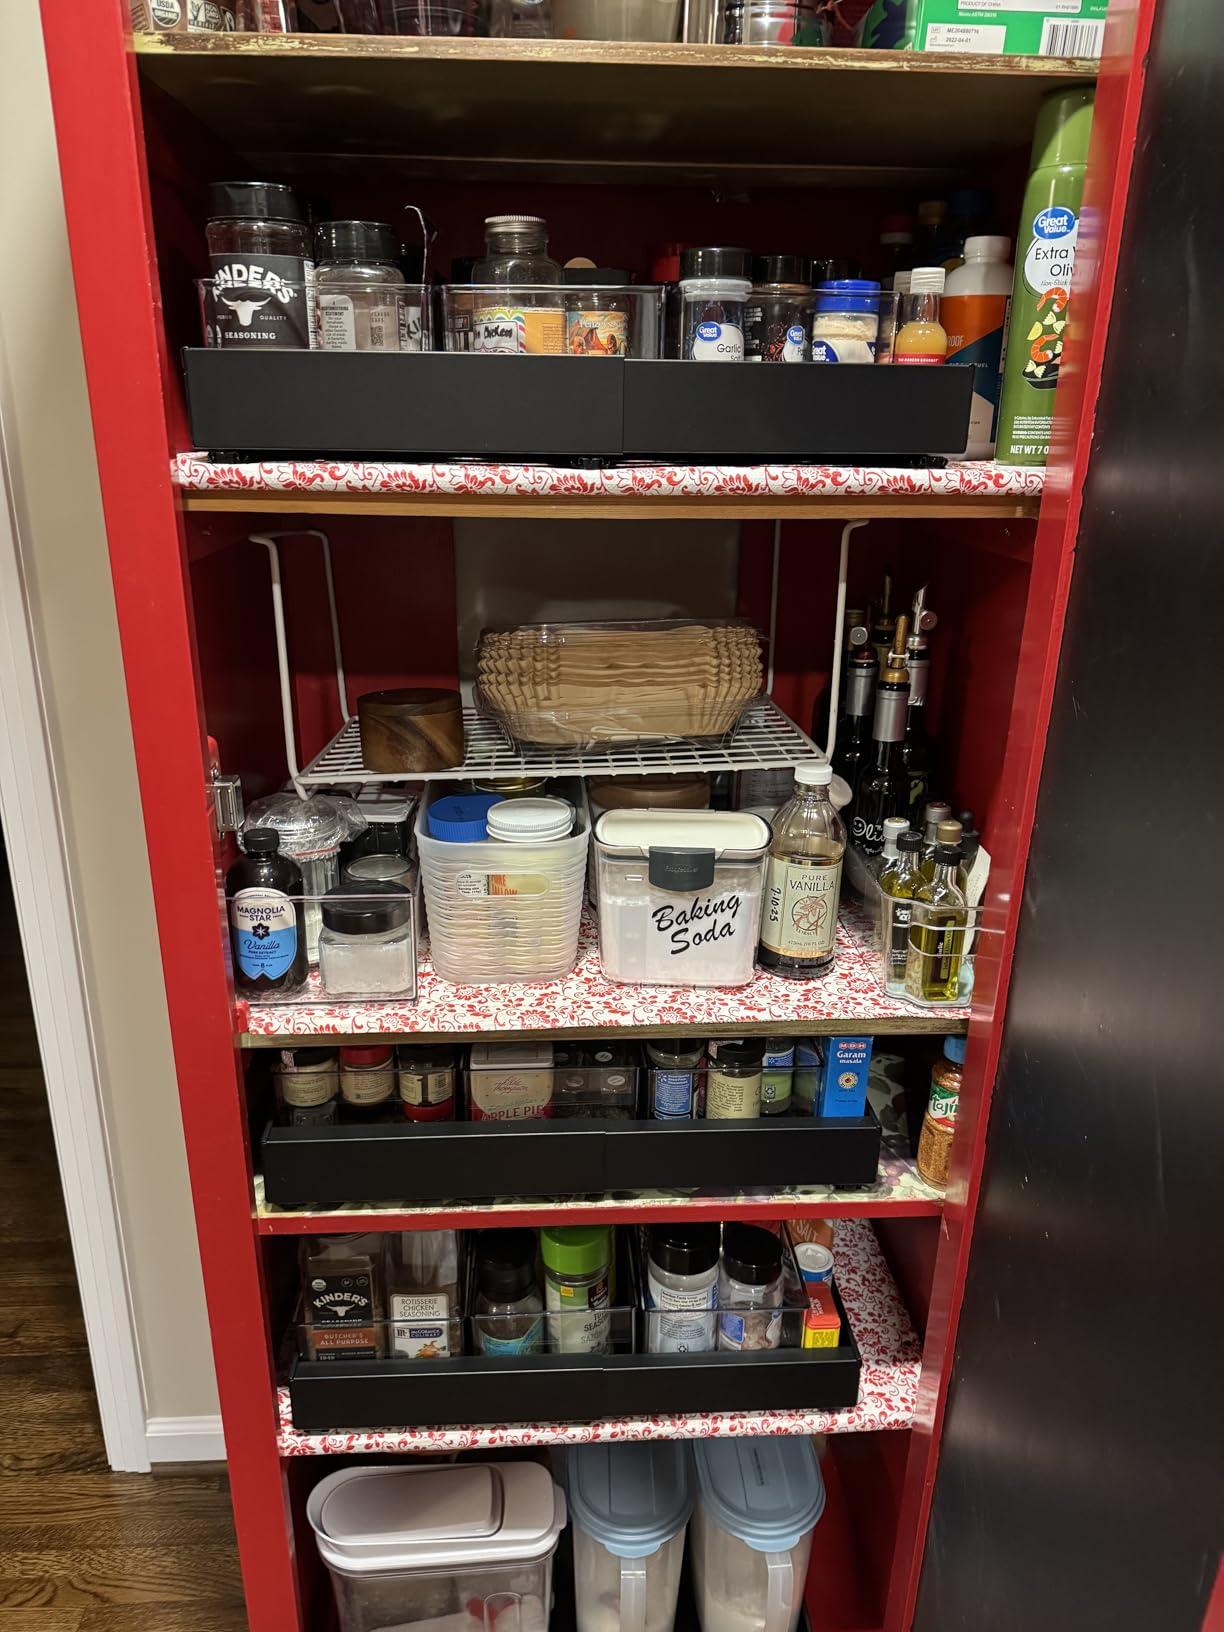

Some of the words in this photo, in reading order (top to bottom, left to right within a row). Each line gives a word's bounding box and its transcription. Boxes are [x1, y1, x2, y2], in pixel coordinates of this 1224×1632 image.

[156, 0, 175, 9] USDA
[1038, 215, 1069, 228] Great
[1044, 226, 1067, 234] Value
[1035, 246, 1069, 261] Extra
[699, 326, 718, 335] Great
[225, 332, 276, 340] SEASONING
[716, 343, 741, 353] Garlic
[1010, 445, 1023, 454] NET
[1024, 445, 1037, 454] WT
[1037, 446, 1043, 454] 7
[789, 880, 835, 892] VANILLA
[236, 905, 286, 915] MAGNOLIA
[652, 895, 742, 932] Baking
[670, 918, 735, 955] Soda
[795, 928, 816, 936] EXTRACT
[244, 939, 280, 950] Vanilla
[836, 1050, 866, 1058] Garam
[482, 1107, 521, 1120] APPLE
[524, 1104, 545, 1116] PIE
[797, 1219, 818, 1242] SALT
[313, 1292, 368, 1308] KINDER'S
